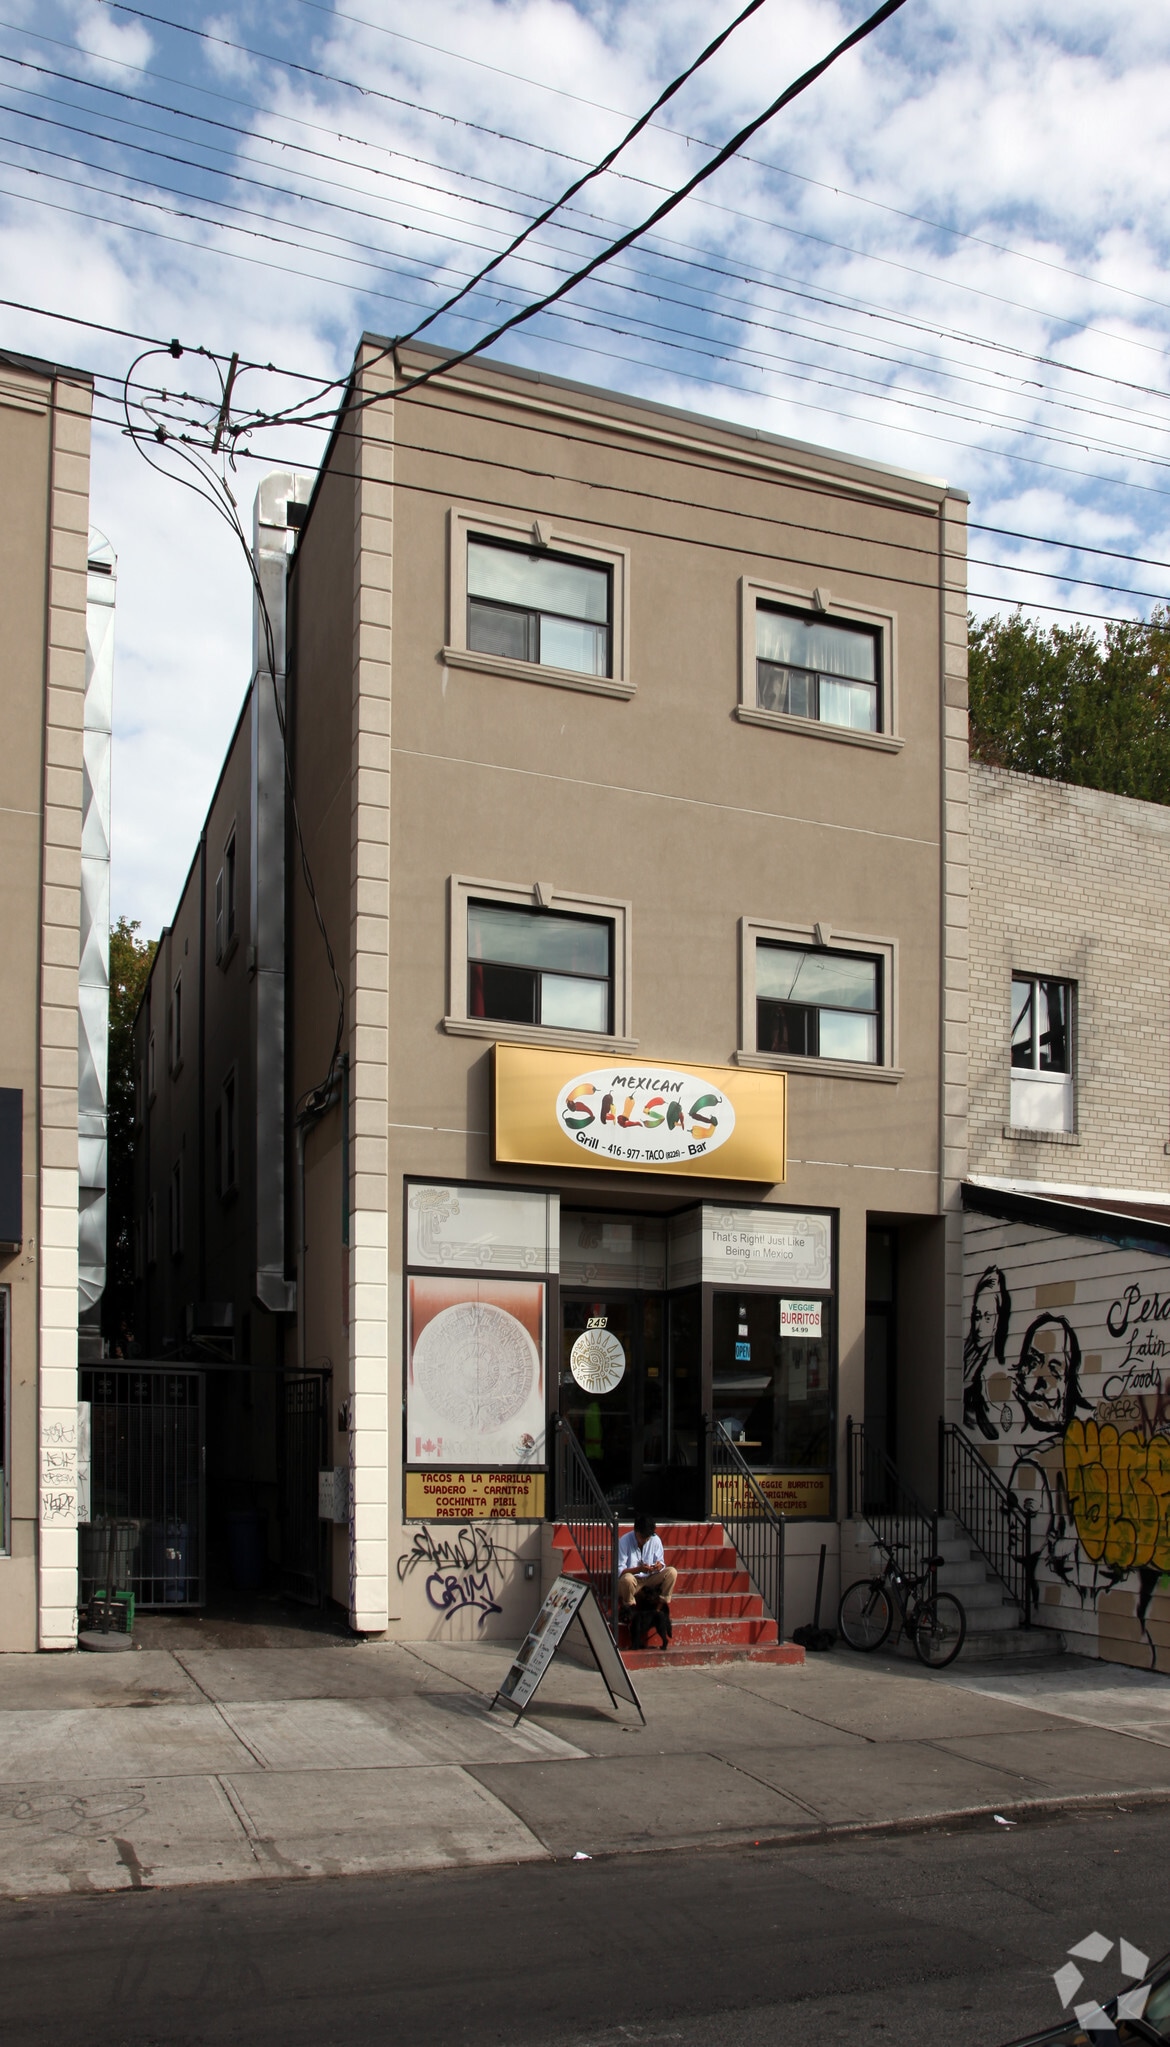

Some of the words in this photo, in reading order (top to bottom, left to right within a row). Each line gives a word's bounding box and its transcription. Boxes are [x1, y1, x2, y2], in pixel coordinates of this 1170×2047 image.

[611, 1075, 685, 1093] MEXICAN
[562, 1083, 723, 1140] SALSAS
[576, 1131, 600, 1150] Grill
[607, 1144, 622, 1156] 416
[626, 1148, 641, 1160] 977
[645, 1149, 665, 1160] TACO
[688, 1141, 708, 1156] Bar
[711, 1231, 738, 1243] That's
[740, 1233, 765, 1246] Right!
[767, 1236, 786, 1246] Just
[787, 1237, 805, 1247] Like
[725, 1245, 751, 1258] Being
[752, 1247, 761, 1257] in
[763, 1248, 794, 1260] Mexico
[788, 1303, 815, 1312] VEGGIE
[588, 1317, 607, 1328] 249
[781, 1312, 820, 1326] BURRITOS
[1119, 1328, 1170, 1368] Latin
[421, 1473, 452, 1483] TACOS
[458, 1474, 465, 1483] A
[471, 1474, 483, 1483] LA
[488, 1474, 532, 1483] PARRILLA
[423, 1485, 467, 1495] SUADERO
[484, 1486, 529, 1495] CARNITAS
[787, 1480, 825, 1489] BURRITOS
[436, 1497, 487, 1507] COCHINITA
[493, 1497, 517, 1507] PIBIL
[774, 1500, 808, 1509] RECIPIES
[436, 1508, 474, 1517] PASTOR
[490, 1508, 517, 1517] MOLE
